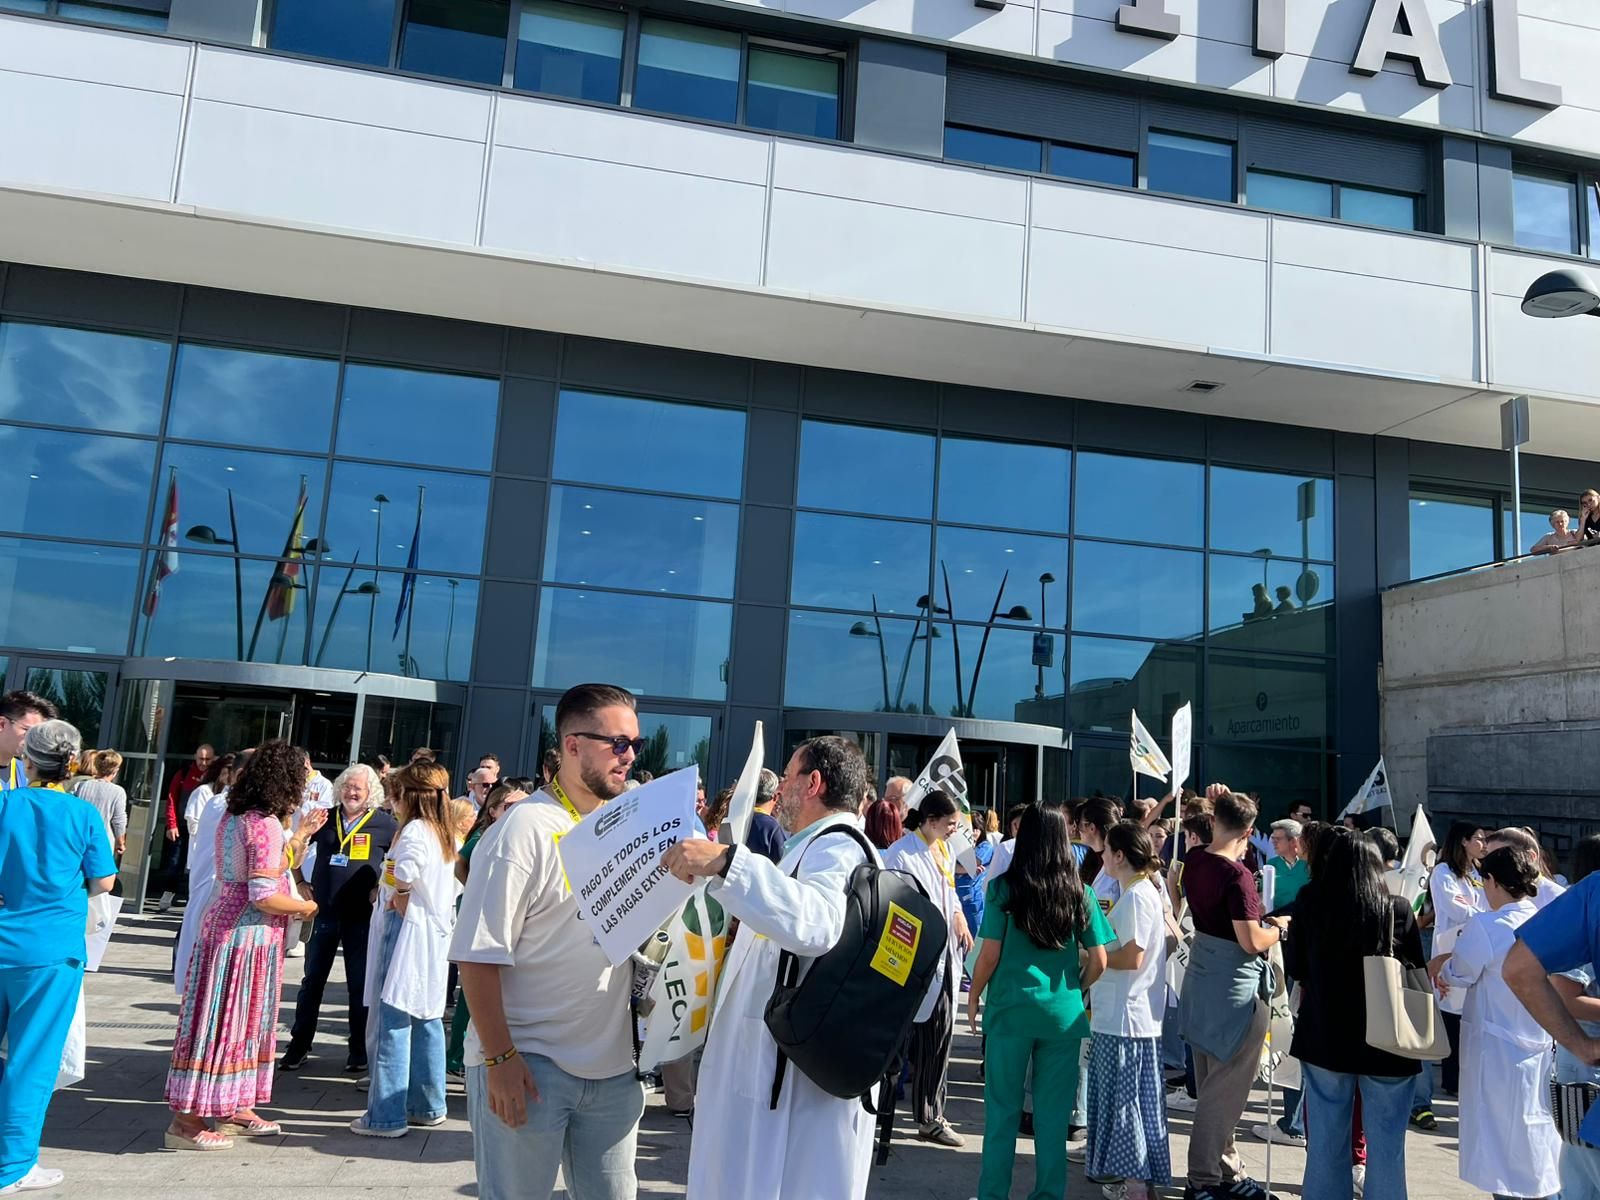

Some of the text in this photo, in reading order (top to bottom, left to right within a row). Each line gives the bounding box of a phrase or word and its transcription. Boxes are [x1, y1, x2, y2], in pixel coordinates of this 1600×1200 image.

[1227, 713, 1300, 738] Aparcamiento
[580, 872, 601, 900] PAGO
[602, 862, 615, 878] DE
[614, 832, 649, 865] TODOS
[653, 817, 681, 837] LOS
[591, 835, 678, 917] COMPLEMENTOS EN
[600, 912, 619, 934] LAS
[617, 888, 644, 919] PAGAS
